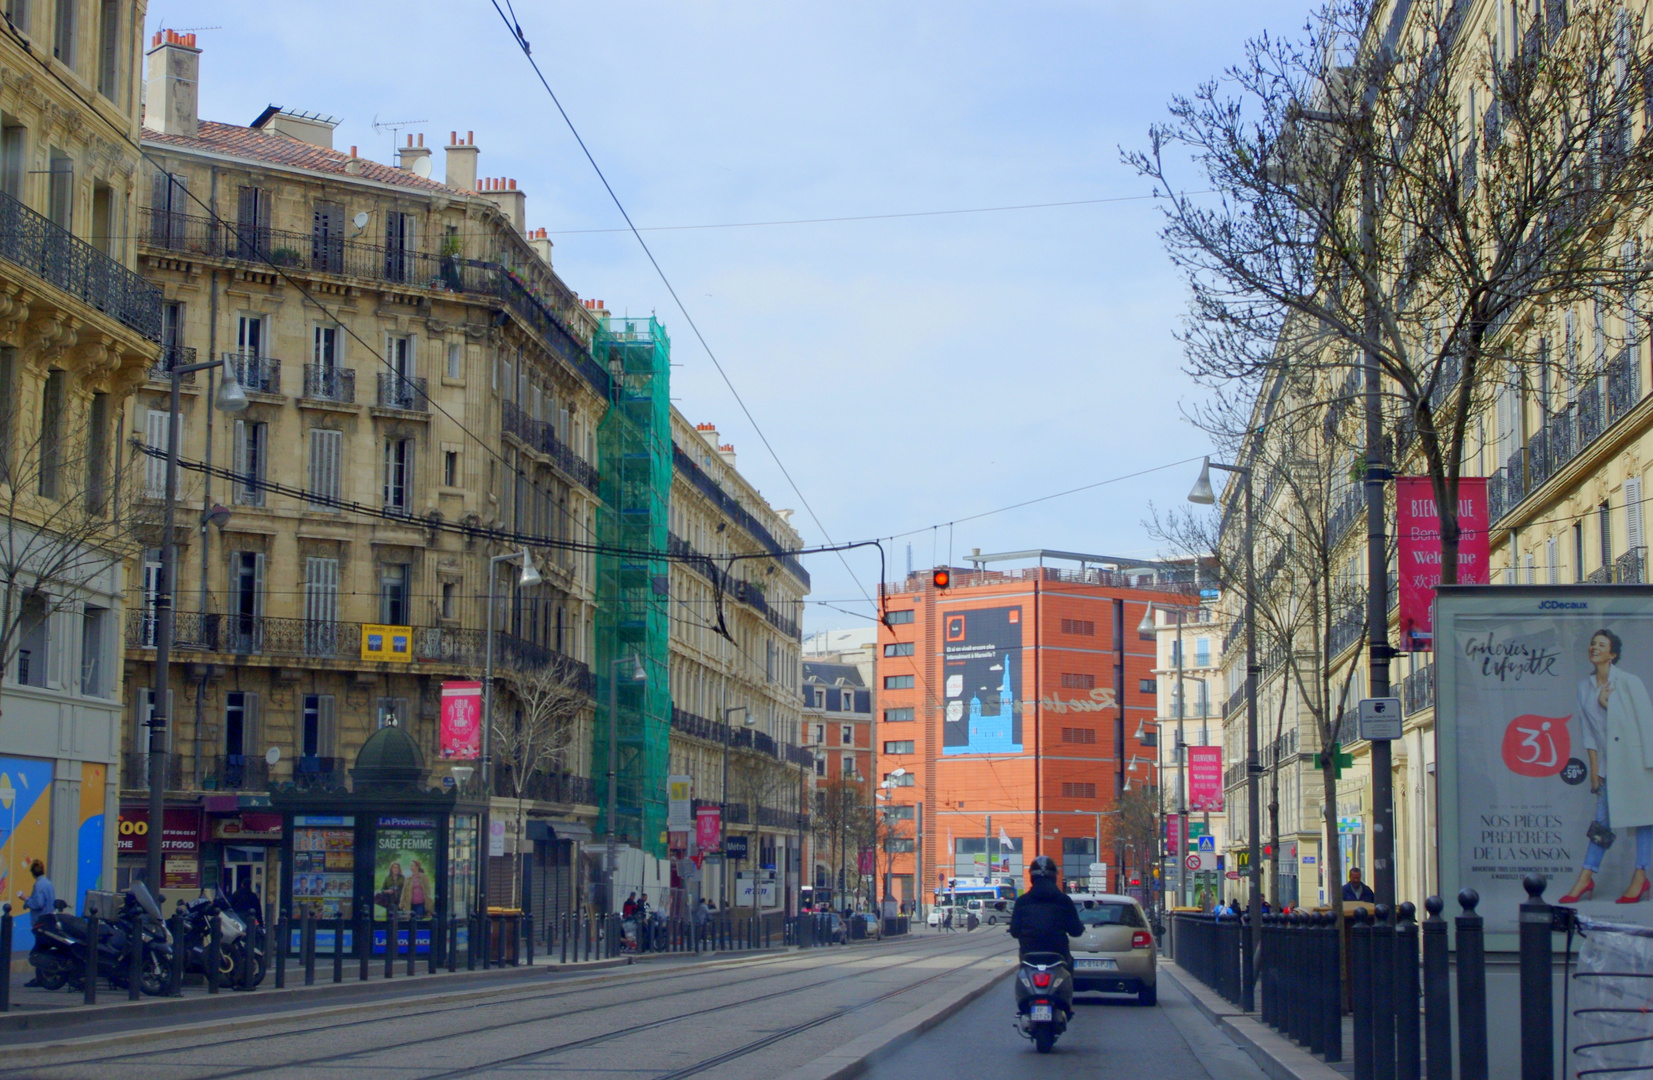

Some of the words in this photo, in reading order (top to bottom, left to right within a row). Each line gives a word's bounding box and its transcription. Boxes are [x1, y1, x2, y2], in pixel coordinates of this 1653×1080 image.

[1411, 499, 1474, 518] BIENUE
[1538, 600, 1588, 610] JCDecaux
[1465, 632, 1529, 661] Galeries
[1482, 648, 1561, 682] Lafayette
[379, 817, 391, 825] La
[1480, 814, 1510, 828] NOS
[1513, 811, 1563, 828] PIÈCES
[171, 841, 195, 849] FOOD
[379, 838, 401, 849] SAGE
[402, 838, 433, 849] FEMME
[1473, 847, 1494, 860] DE
[1519, 847, 1570, 860] SAISON
[375, 937, 387, 945] La
